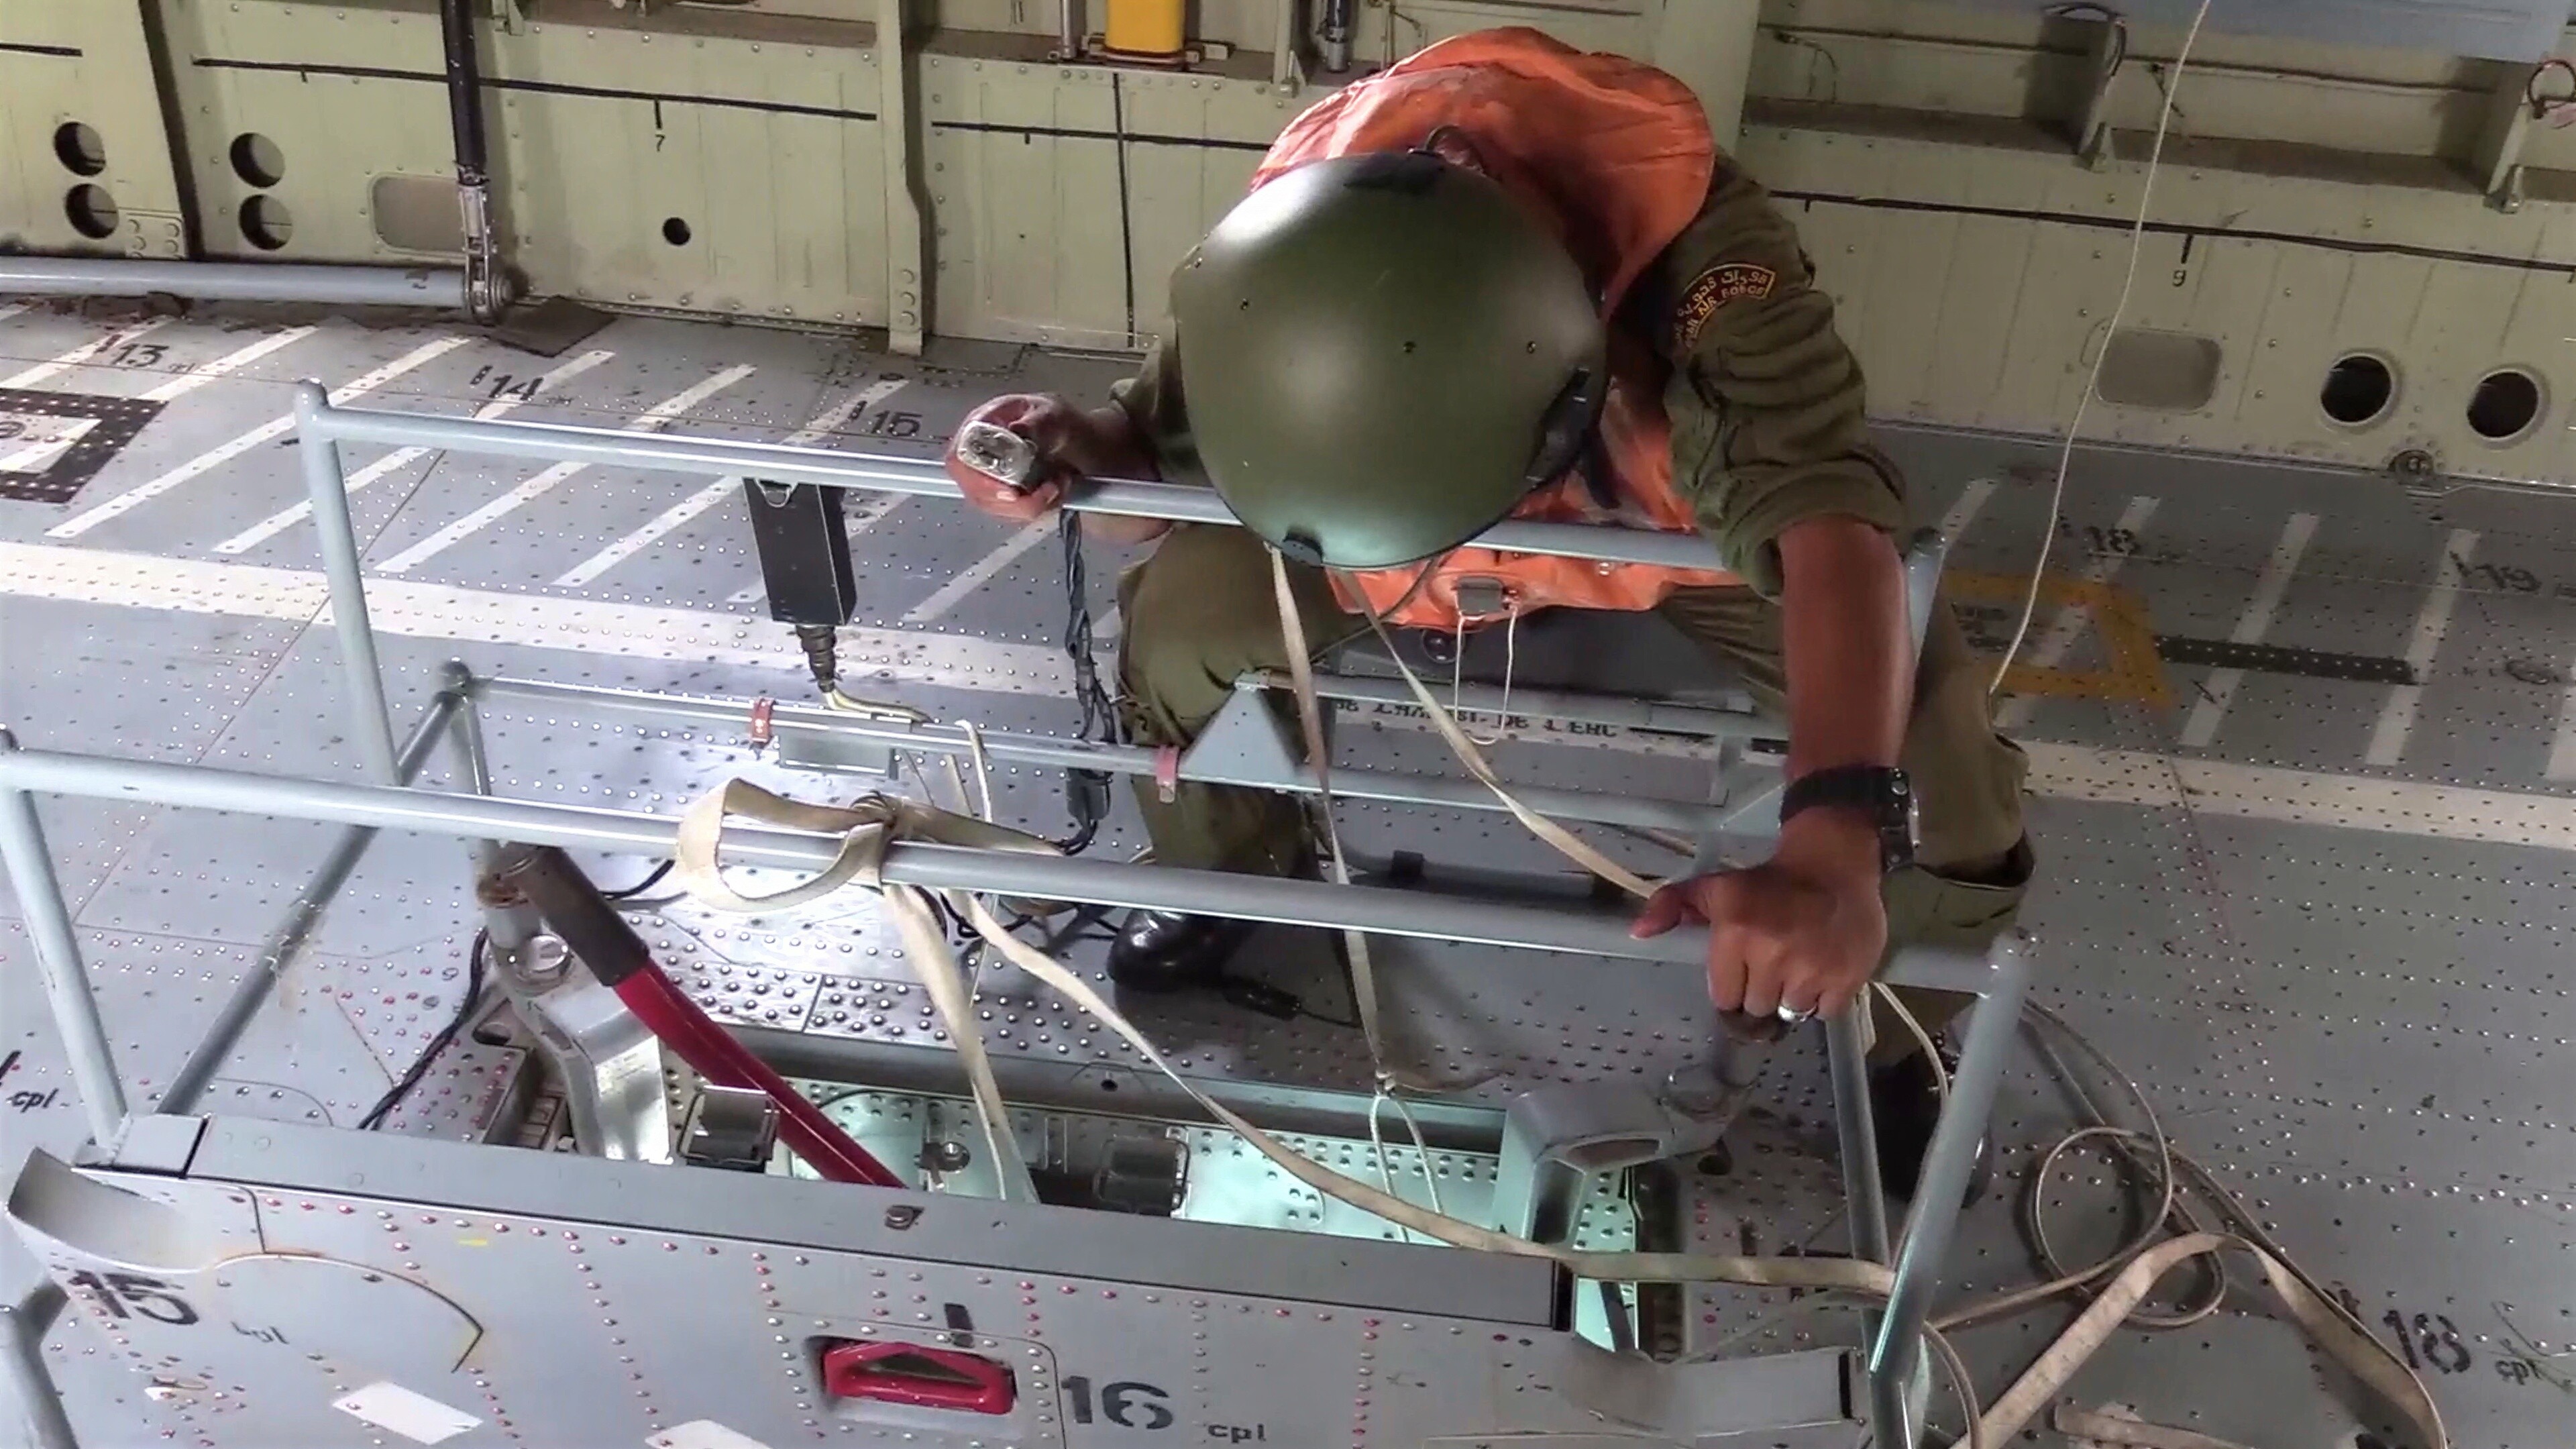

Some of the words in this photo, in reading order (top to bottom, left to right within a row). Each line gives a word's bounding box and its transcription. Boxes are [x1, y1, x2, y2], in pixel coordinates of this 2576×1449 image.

[655, 133, 665, 152] 7
[2173, 270, 2186, 287] 9
[112, 343, 169, 367] 13
[489, 374, 545, 401] 14
[871, 411, 922, 437] 15
[2083, 526, 2141, 555] 18
[2475, 563, 2542, 592] 19
[11, 1087, 59, 1113] cpl
[68, 1269, 199, 1325] 15
[2383, 1309, 2471, 1374] 18
[2495, 1358, 2541, 1385] cpl
[1061, 1375, 1173, 1430] 16
[1208, 1423, 1267, 1443] cpl
